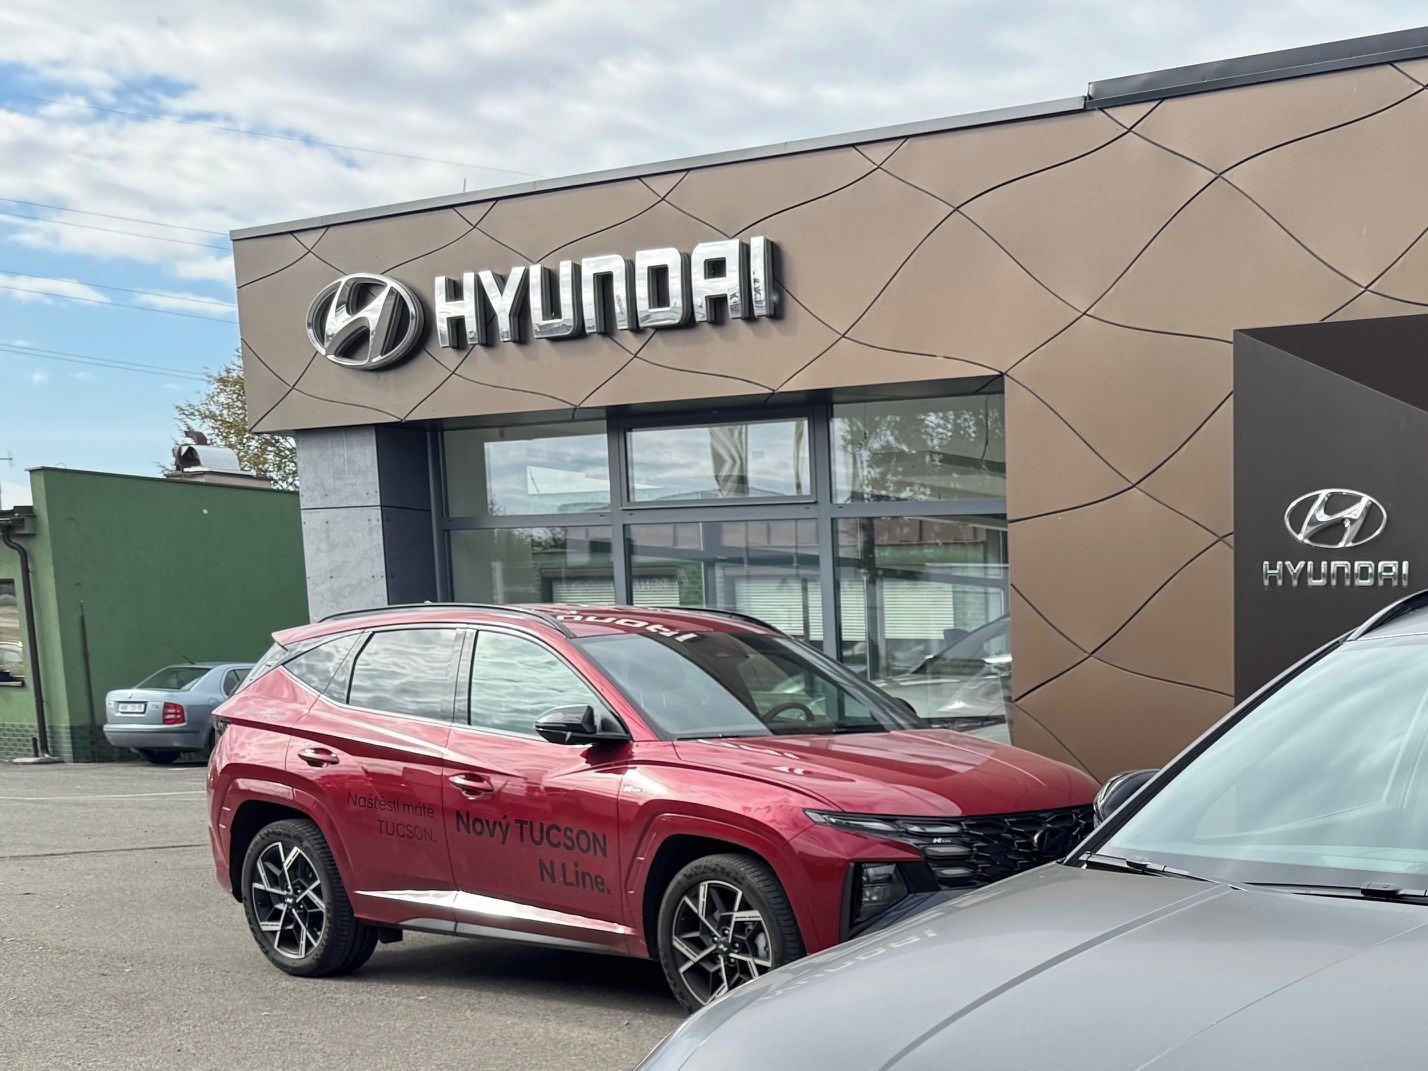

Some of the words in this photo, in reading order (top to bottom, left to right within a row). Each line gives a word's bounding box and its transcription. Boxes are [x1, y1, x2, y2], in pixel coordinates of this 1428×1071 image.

[434, 236, 777, 349] HYUNDAI
[1262, 561, 1410, 588] HYUNDAI
[402, 801, 435, 818] máte
[455, 809, 512, 845] Nový
[514, 818, 608, 858] TUCSON
[538, 858, 557, 884] N
[561, 861, 612, 896] Line.
